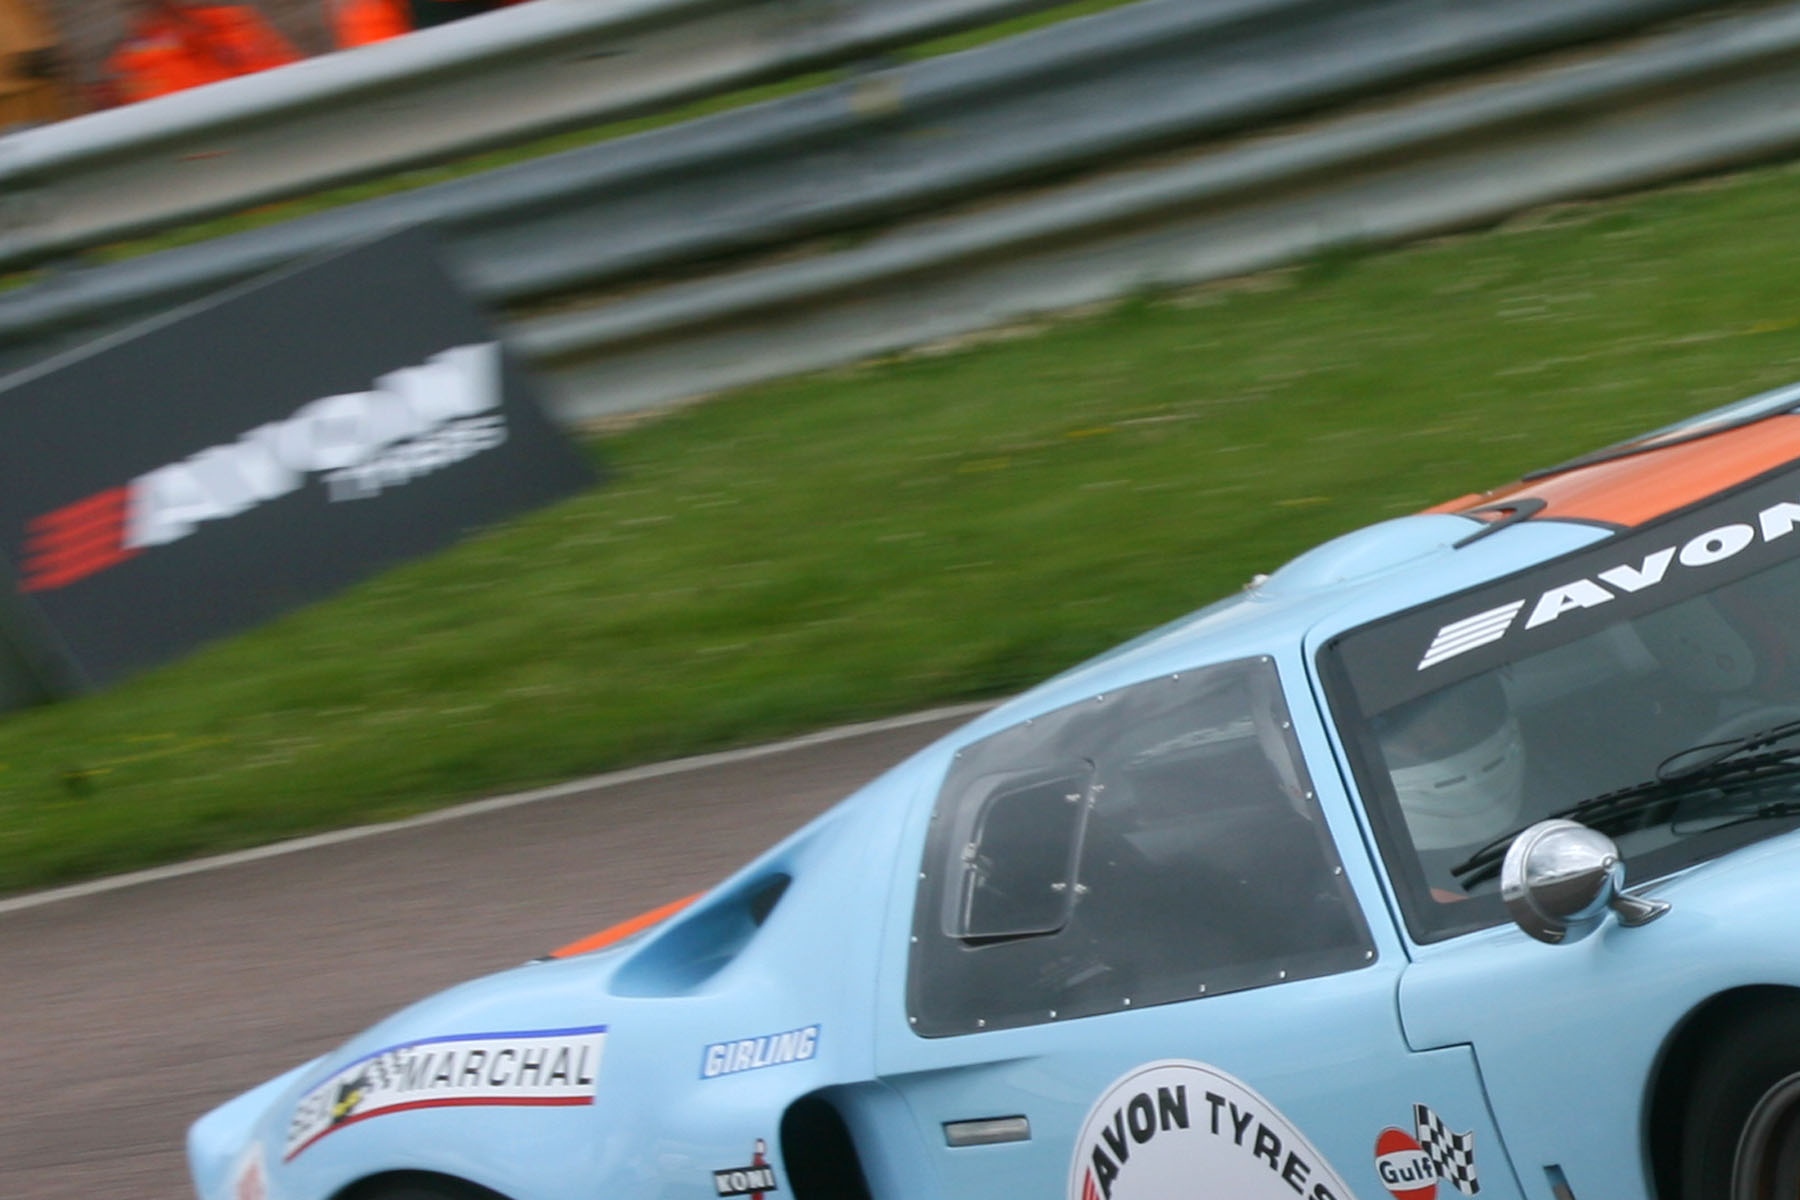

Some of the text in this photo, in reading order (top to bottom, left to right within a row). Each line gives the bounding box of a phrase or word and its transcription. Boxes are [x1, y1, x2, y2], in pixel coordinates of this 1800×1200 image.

[704, 1026, 818, 1077] GIRLING
[715, 1167, 776, 1193] KONI
[1378, 1155, 1436, 1185] Gulf
